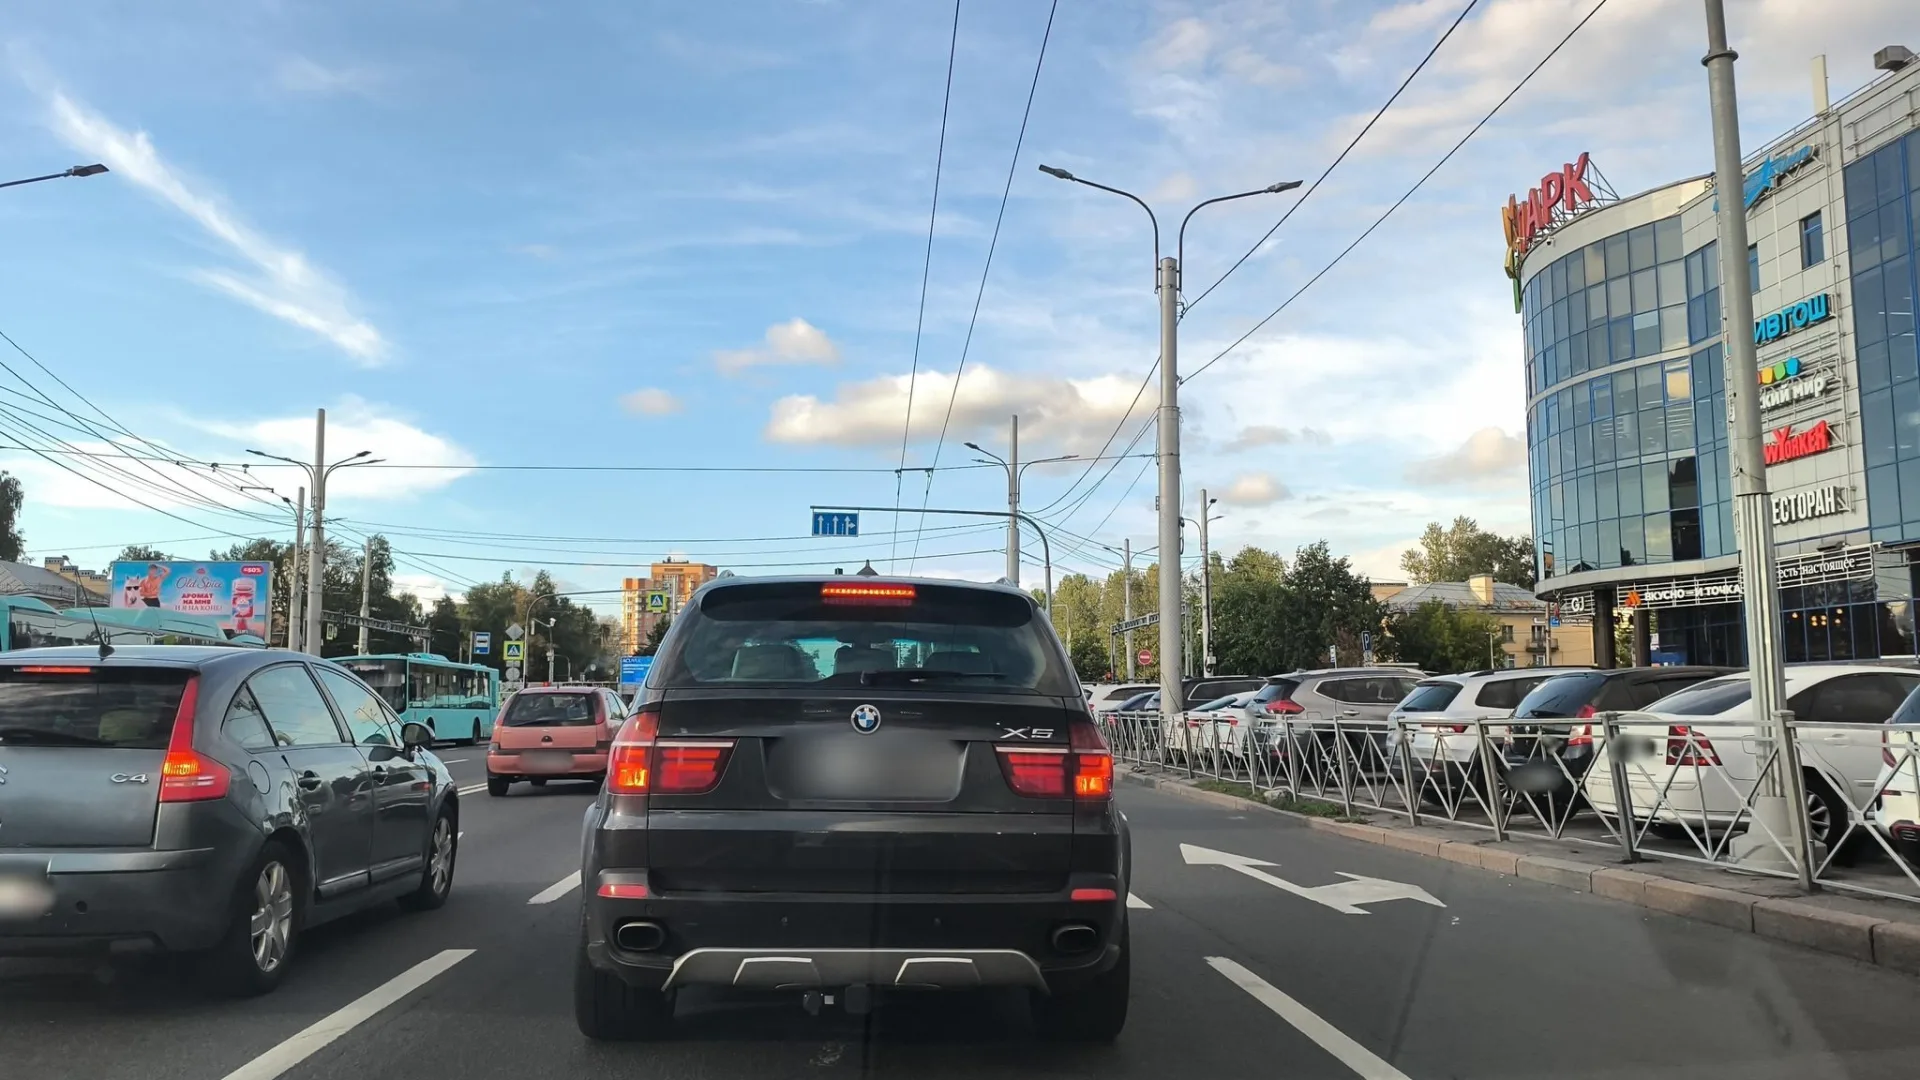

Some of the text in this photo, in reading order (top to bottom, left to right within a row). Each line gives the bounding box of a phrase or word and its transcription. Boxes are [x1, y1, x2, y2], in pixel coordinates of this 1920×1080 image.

[1754, 293, 1828, 344] ИВГОШ
[1760, 384, 1790, 409] кий
[1771, 485, 1836, 525] ЕСТОРАН
[1778, 557, 1856, 579] есть настоящее
[176, 576, 223, 591] Old Spice
[1644, 589, 1685, 602] ВКУСНО
[1705, 583, 1743, 596] ТОЧКА
[1571, 596, 1585, 613] GJ
[1000, 727, 1055, 740] X5
[110, 772, 148, 784] C4
